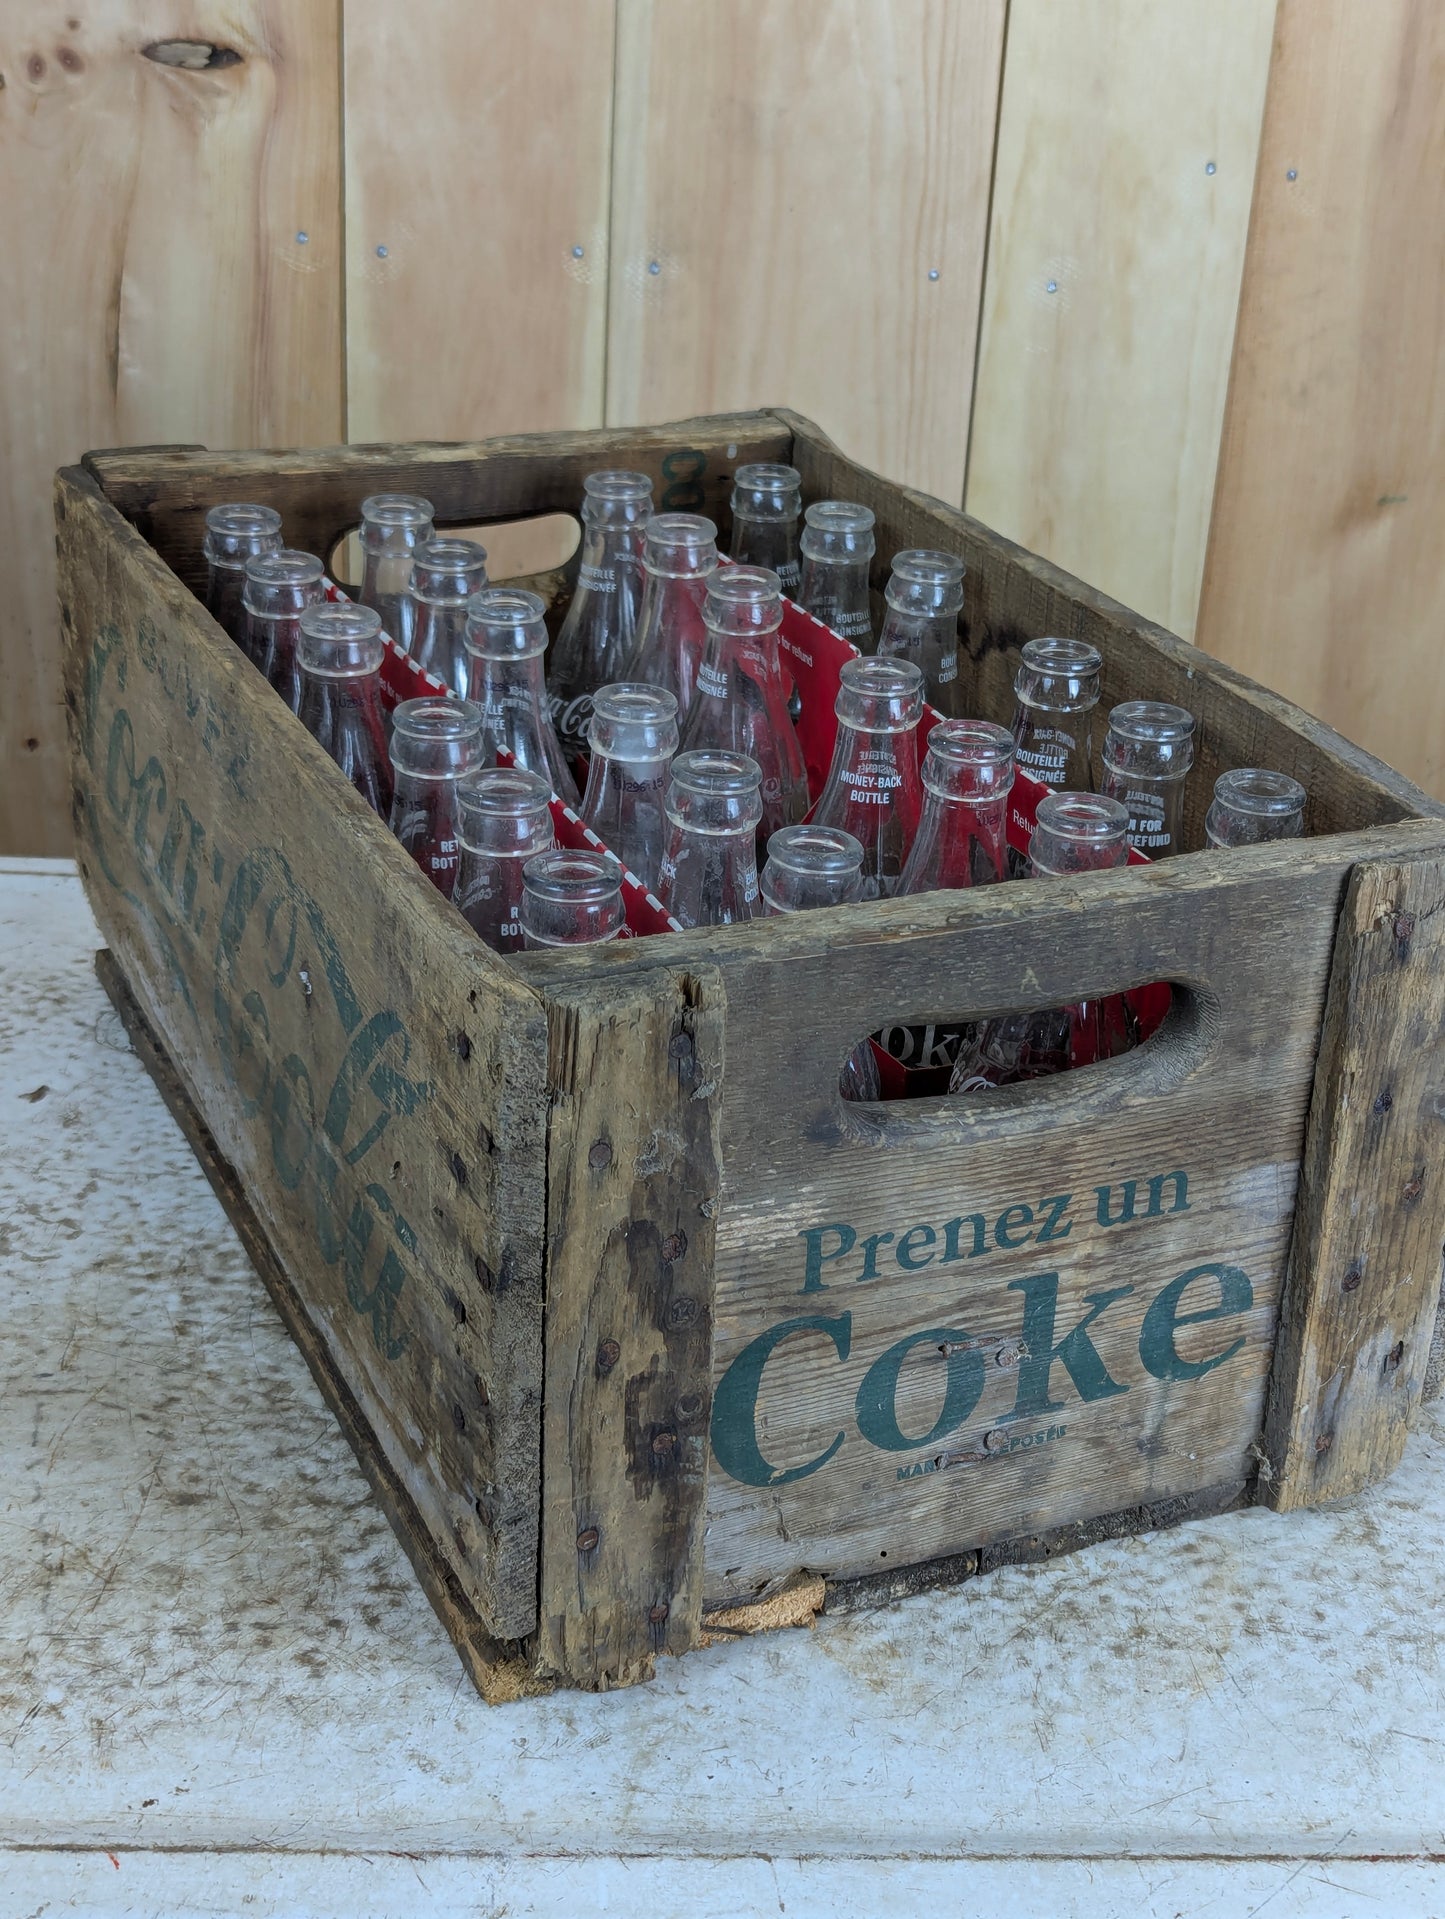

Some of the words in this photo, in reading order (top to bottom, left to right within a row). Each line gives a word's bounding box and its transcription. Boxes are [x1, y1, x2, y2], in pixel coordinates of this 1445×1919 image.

[1016, 748, 1066, 768] BOUTEILLE
[840, 770, 902, 789] MONEY-BACK
[1021, 766, 1067, 783] SIGNÉE
[850, 789, 890, 804] BOTTLE
[1013, 808, 1035, 834] Retu
[1140, 819, 1163, 832] FOR
[1127, 833, 1171, 848] REFUND
[800, 1193, 1073, 1295] Prenez
[1095, 1170, 1192, 1228] un
[710, 1262, 1254, 1487] Coke
